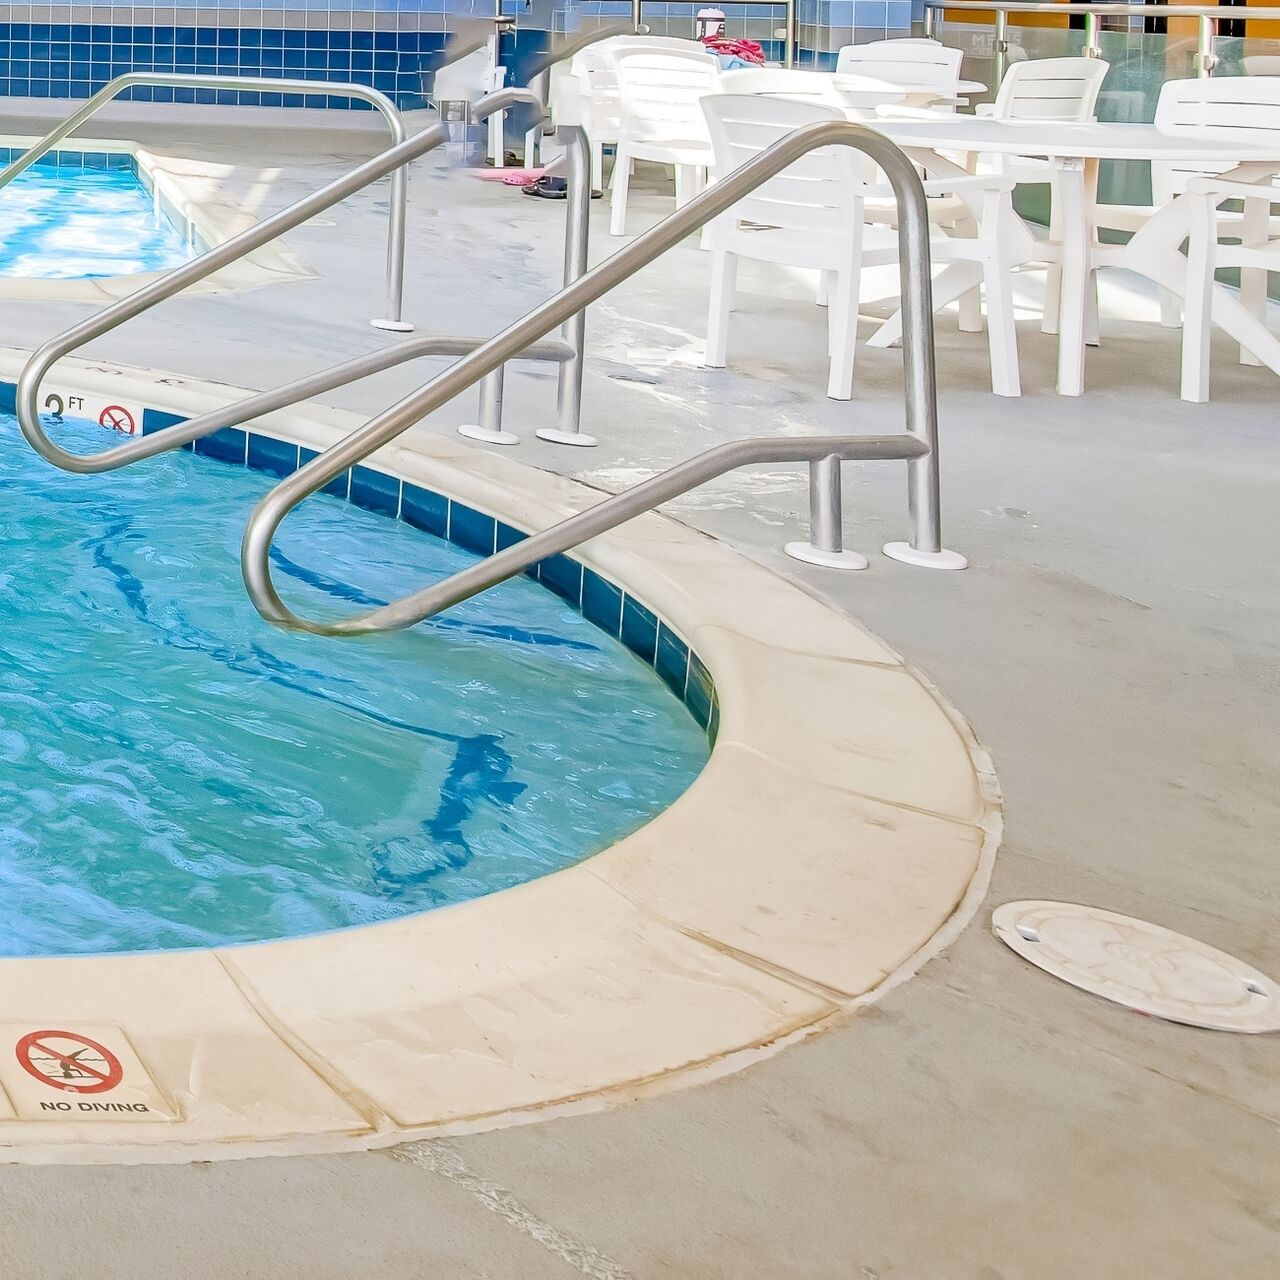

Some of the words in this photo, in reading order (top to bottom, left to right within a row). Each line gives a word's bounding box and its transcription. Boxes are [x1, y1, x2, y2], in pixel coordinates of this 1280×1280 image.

[69, 396, 84, 410] FT
[40, 1101, 72, 1112] NO
[77, 1101, 149, 1113] DIVING
